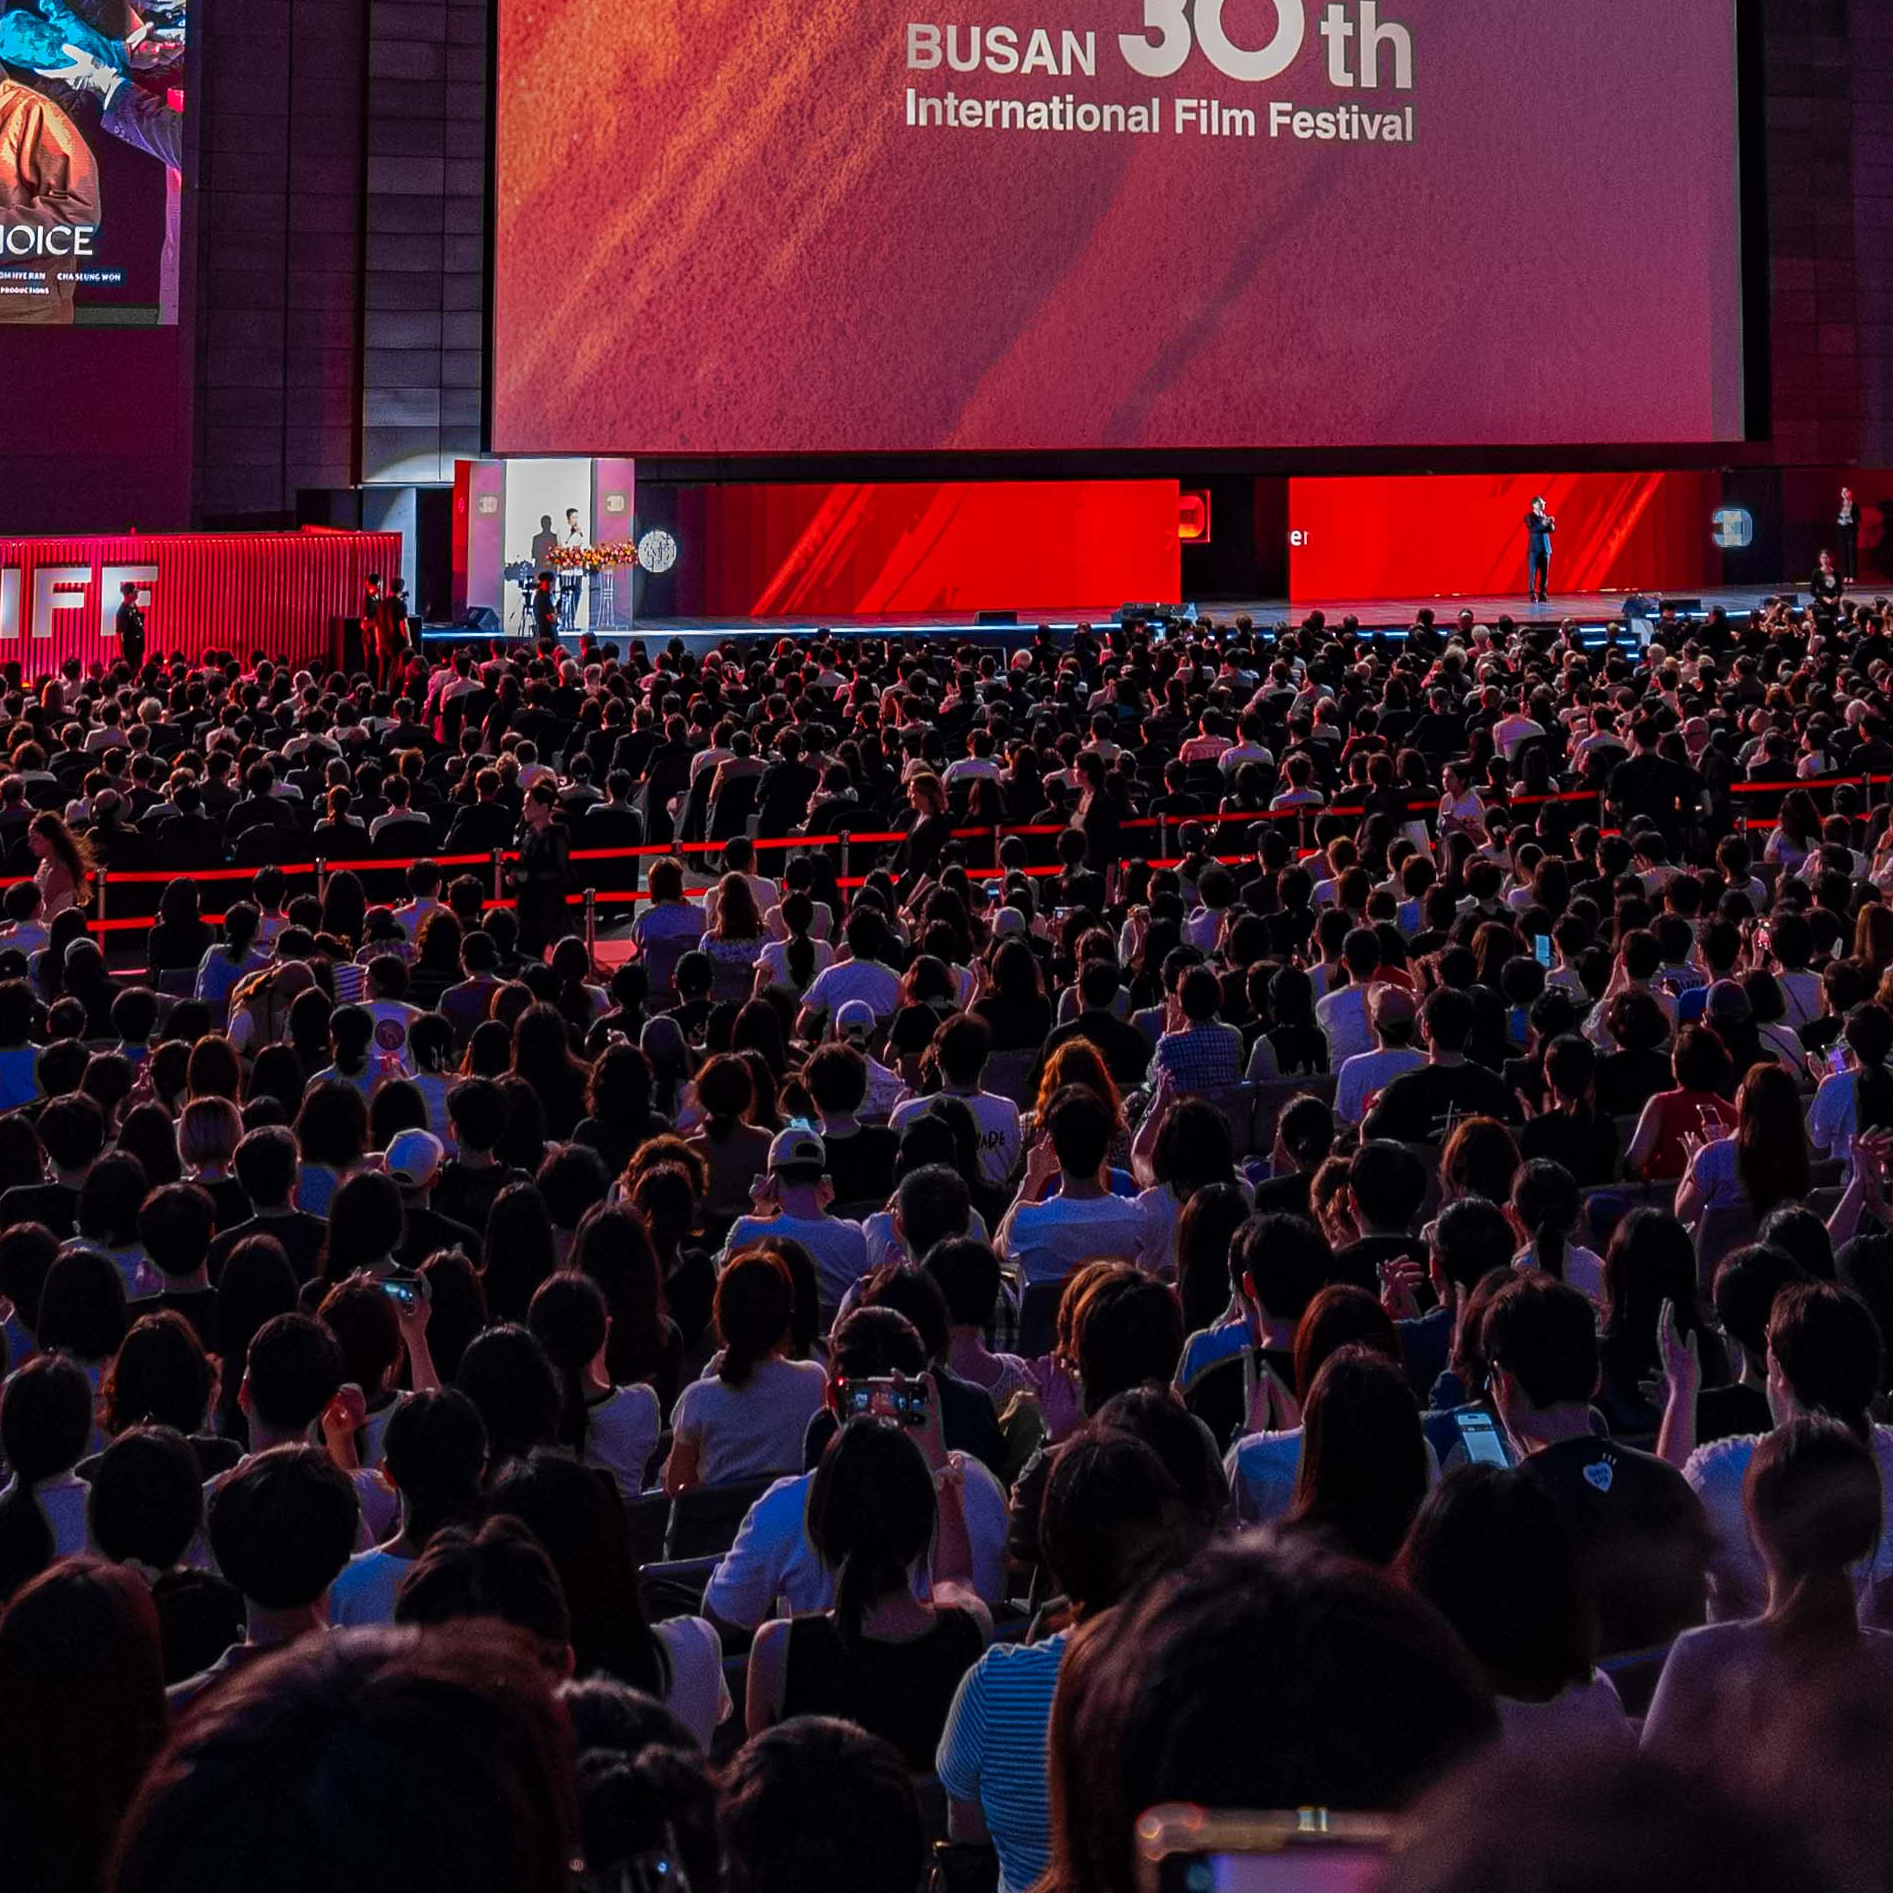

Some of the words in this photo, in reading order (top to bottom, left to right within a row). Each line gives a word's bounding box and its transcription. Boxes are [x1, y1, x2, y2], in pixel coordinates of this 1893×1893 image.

[906, 22, 1097, 76] BUSAN
[905, 88, 1160, 134] International
[1175, 98, 1256, 137] Film
[1269, 102, 1414, 142] Festival
[102, 275, 122, 283] WON
